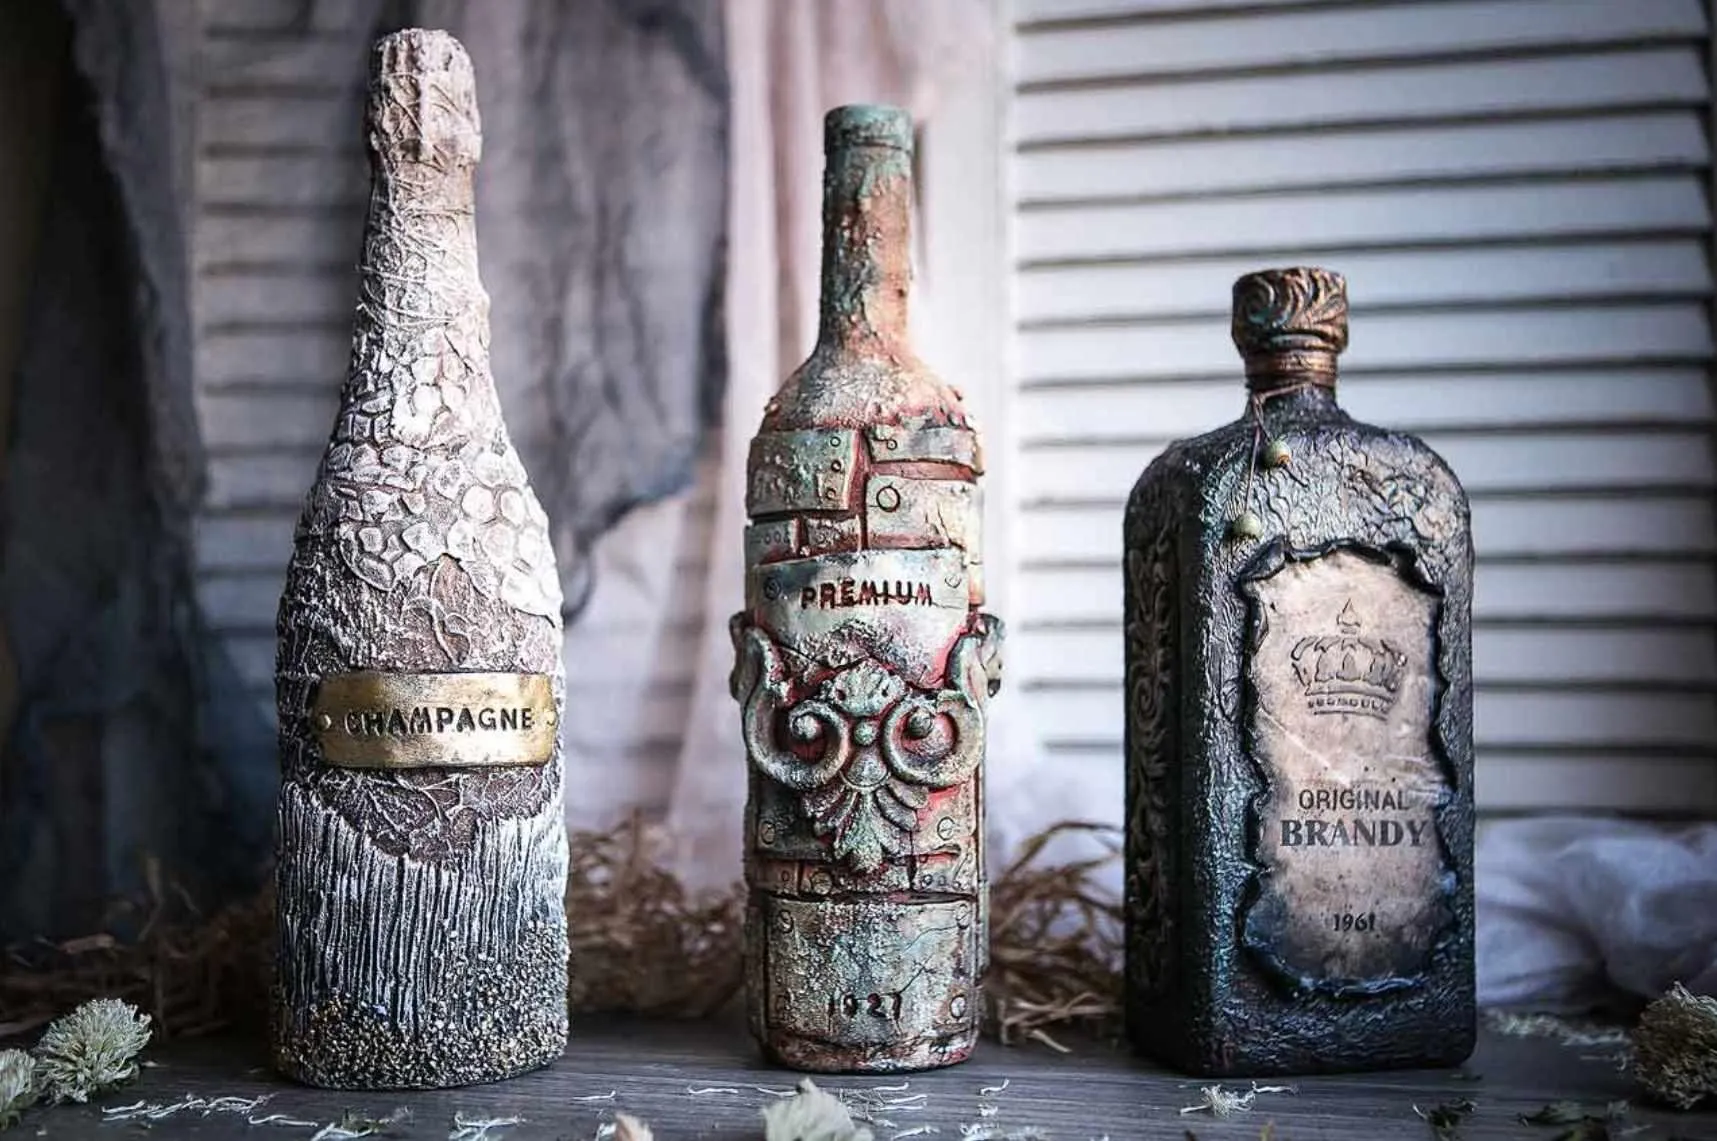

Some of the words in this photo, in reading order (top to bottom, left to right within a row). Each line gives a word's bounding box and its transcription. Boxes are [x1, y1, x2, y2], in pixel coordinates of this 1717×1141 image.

[801, 577, 932, 609] PREMIUM
[345, 706, 534, 736] CHAMPAGNE
[1299, 789, 1410, 811] ORIGINAL
[1280, 819, 1427, 847] BRANDY
[1333, 912, 1376, 932] 1961
